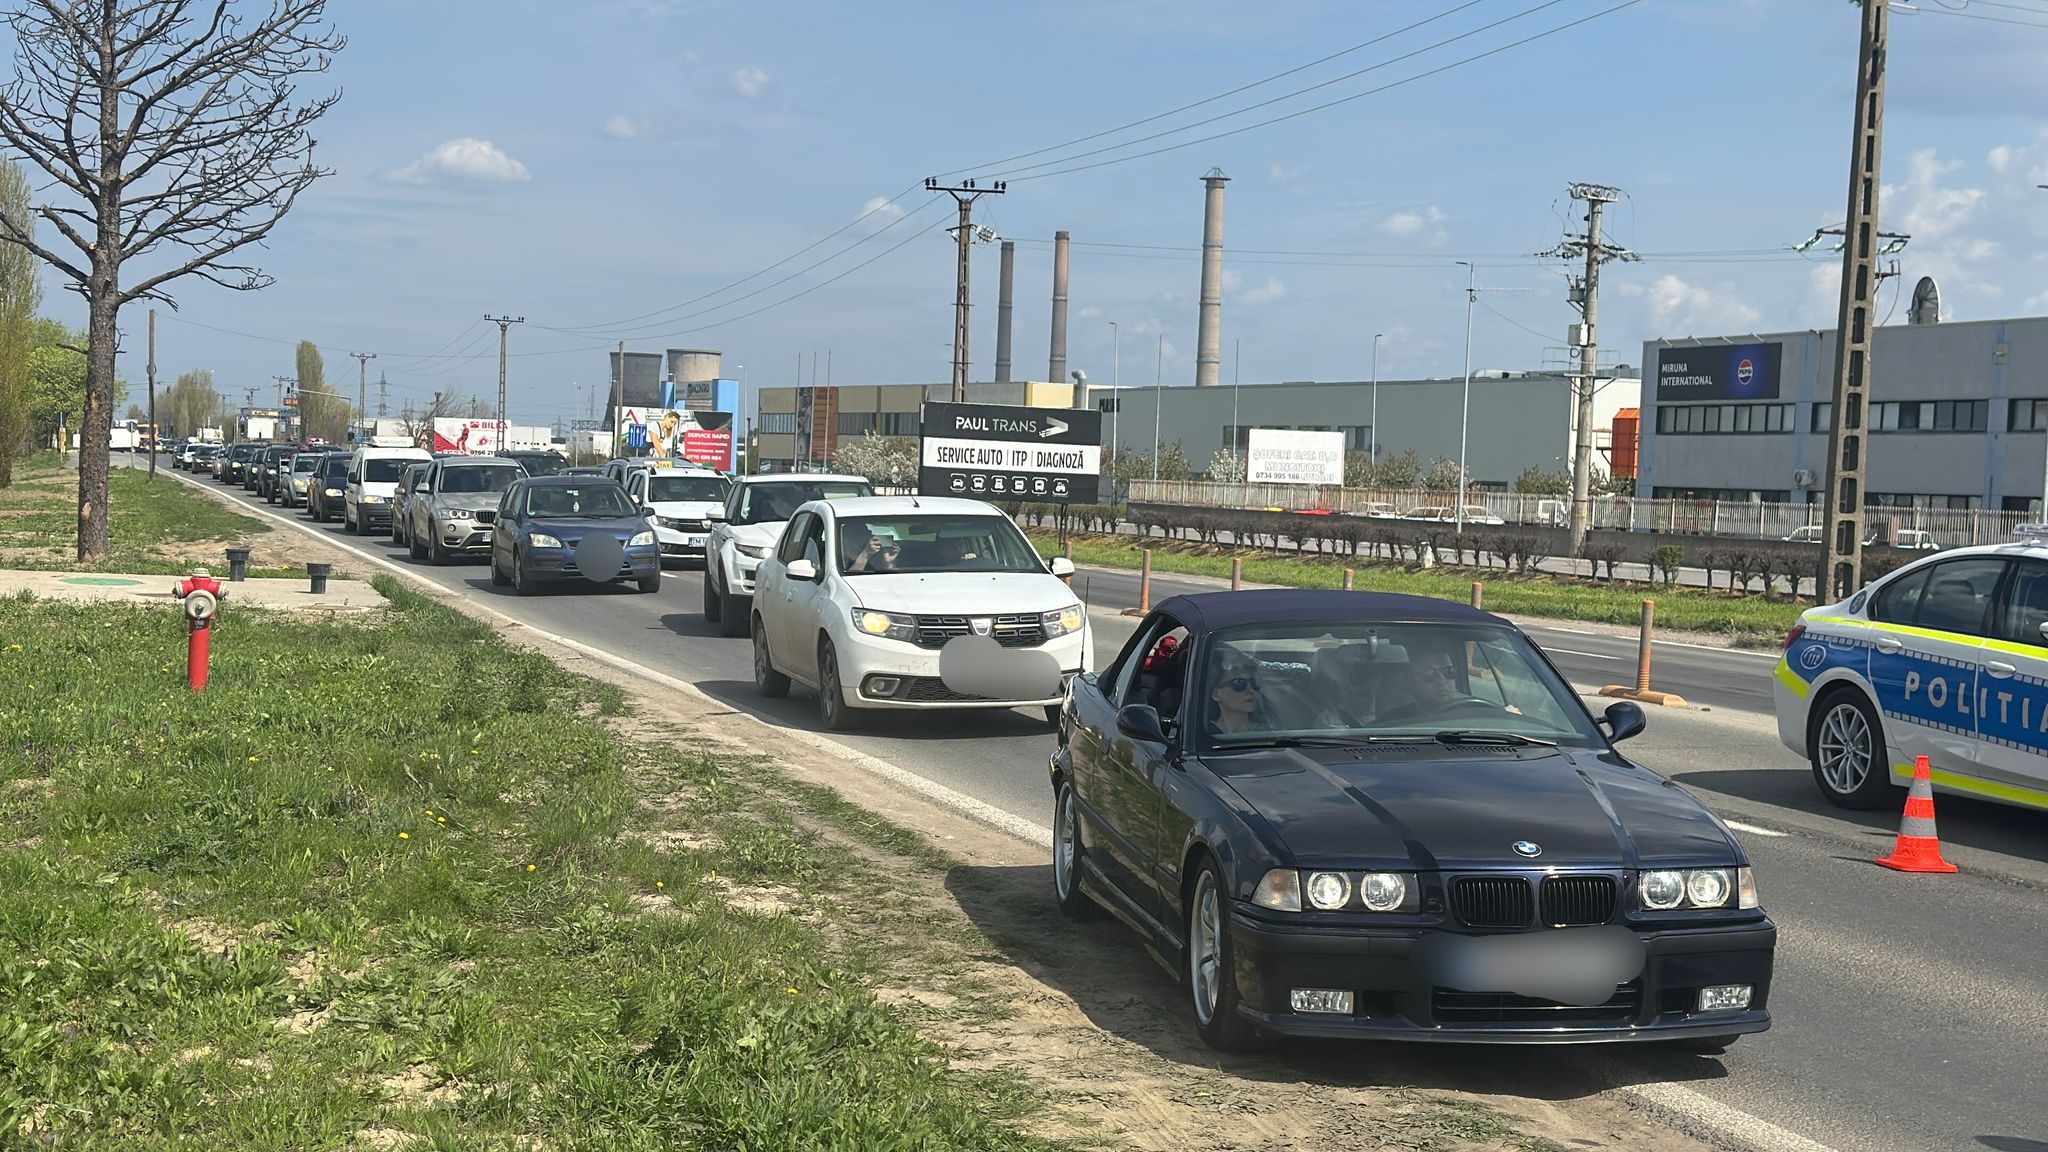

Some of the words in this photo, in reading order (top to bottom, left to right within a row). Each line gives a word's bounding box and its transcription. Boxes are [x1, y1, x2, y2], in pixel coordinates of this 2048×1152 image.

[1661, 363, 1688, 373] MIRUNA
[1661, 376, 1713, 386] INTERNATIONAL
[955, 416, 989, 431] PAUL
[992, 418, 1037, 433] TRANS
[937, 446, 975, 464] SERVICE
[977, 449, 1003, 466] AUTO
[1012, 450, 1028, 467] ITP
[1036, 451, 1084, 469] DIAGNOZĂ
[1255, 471, 1272, 479] 0734
[1807, 653, 1820, 665] 112
